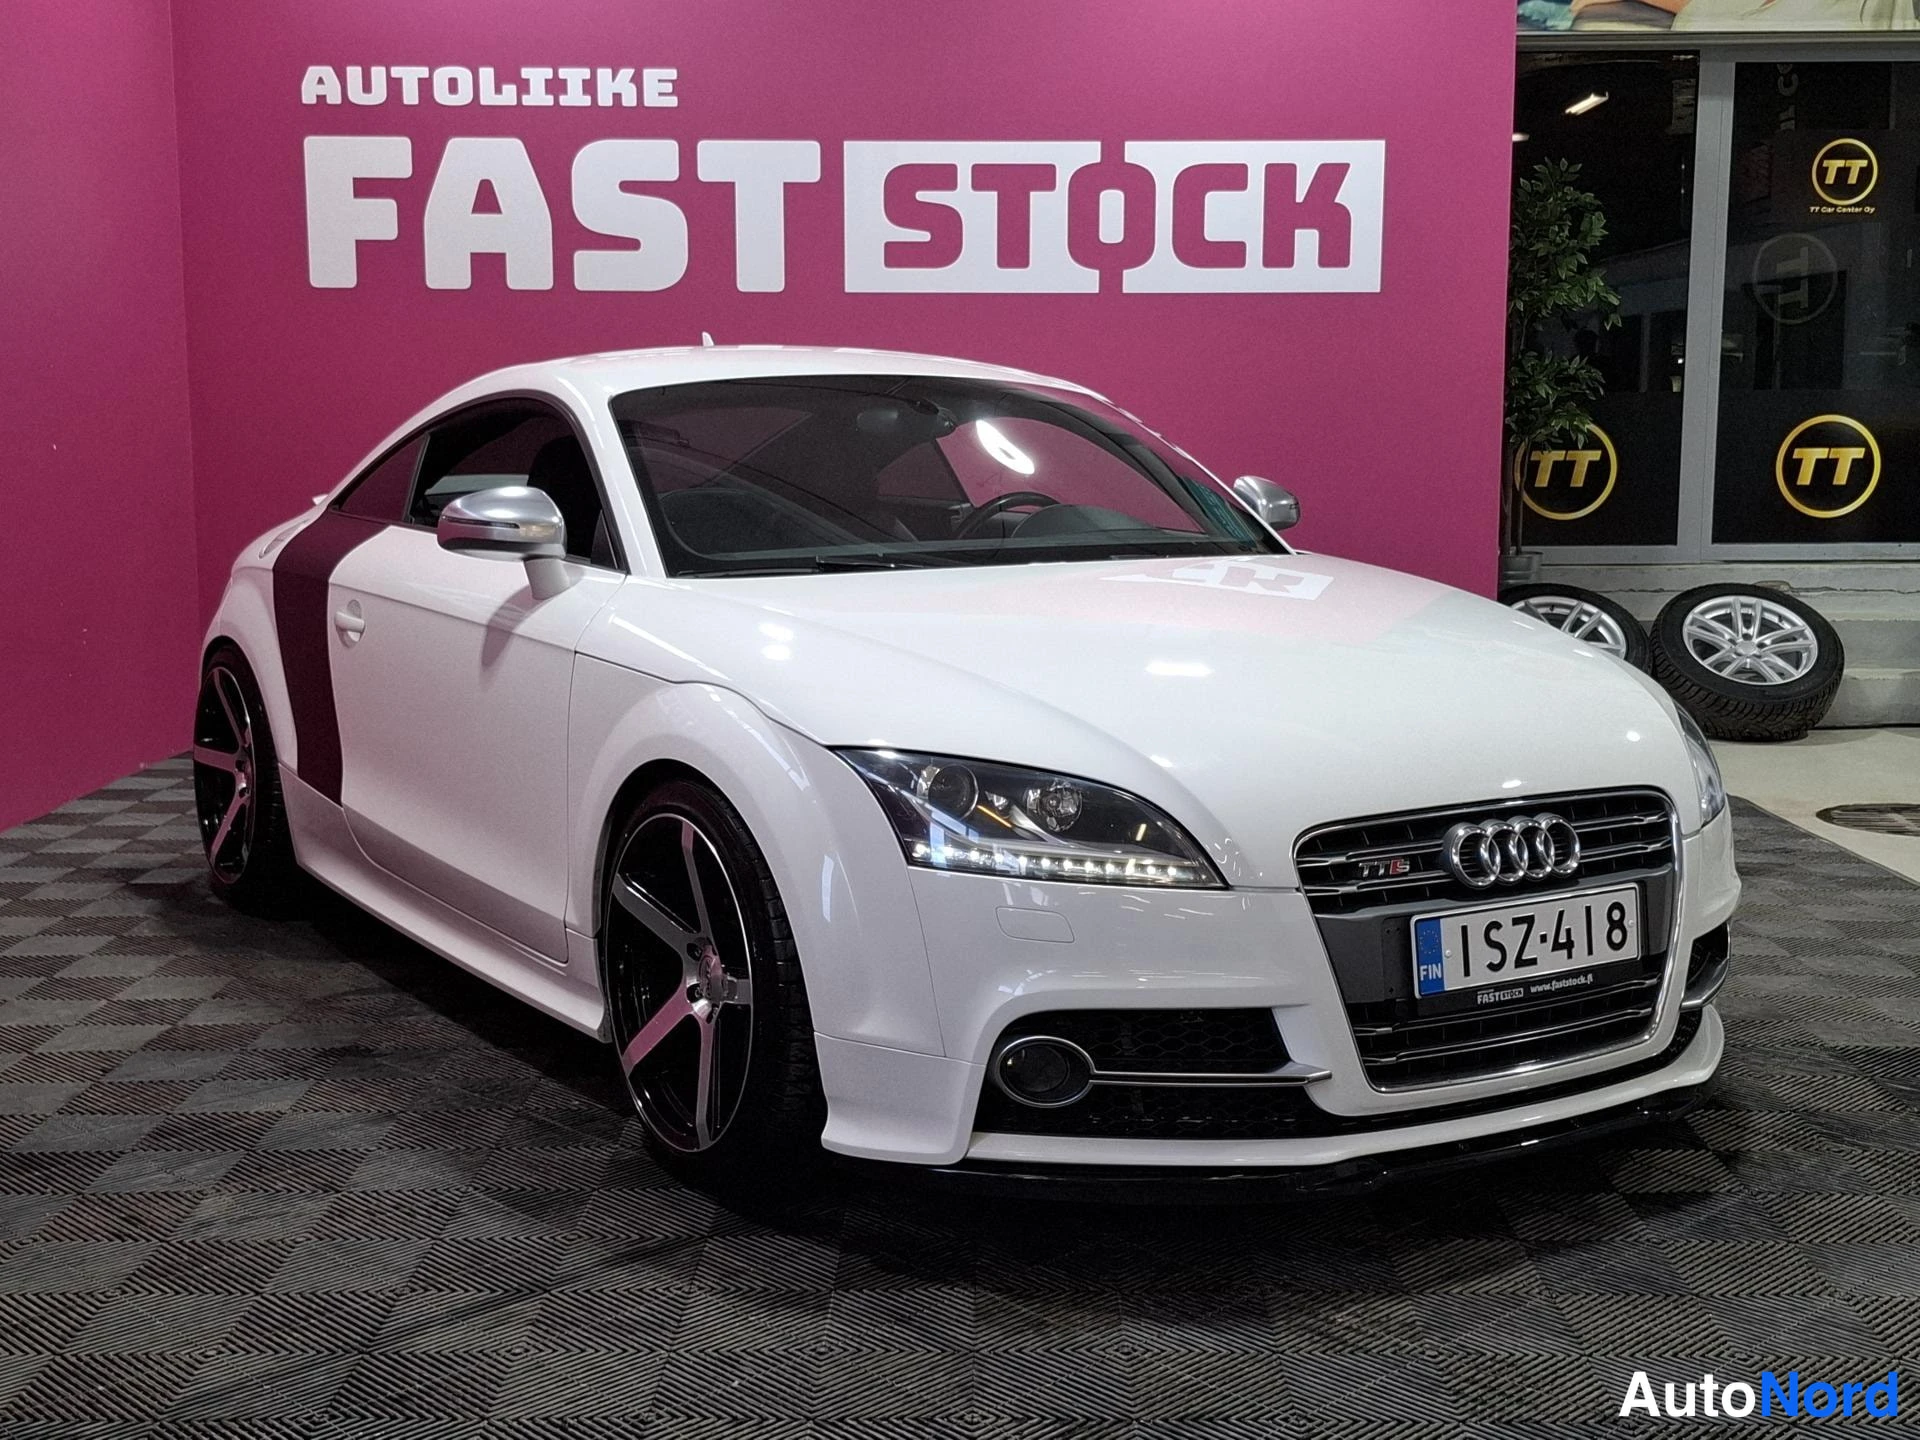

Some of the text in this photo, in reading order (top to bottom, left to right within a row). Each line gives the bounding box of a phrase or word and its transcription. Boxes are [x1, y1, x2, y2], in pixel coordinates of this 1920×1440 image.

[301, 65, 678, 107] AUTOLIIKE
[1822, 159, 1868, 185] TT
[303, 135, 1353, 292] FAST STOCK
[1864, 206, 1875, 214] Oy
[1530, 449, 1602, 488] TT
[1792, 447, 1866, 486] TT
[1358, 858, 1410, 877] TTS
[1419, 901, 1628, 981] FIN ISZ-418
[1477, 992, 1500, 1005] FAST
[1530, 973, 1593, 992] www.faststock.fi
